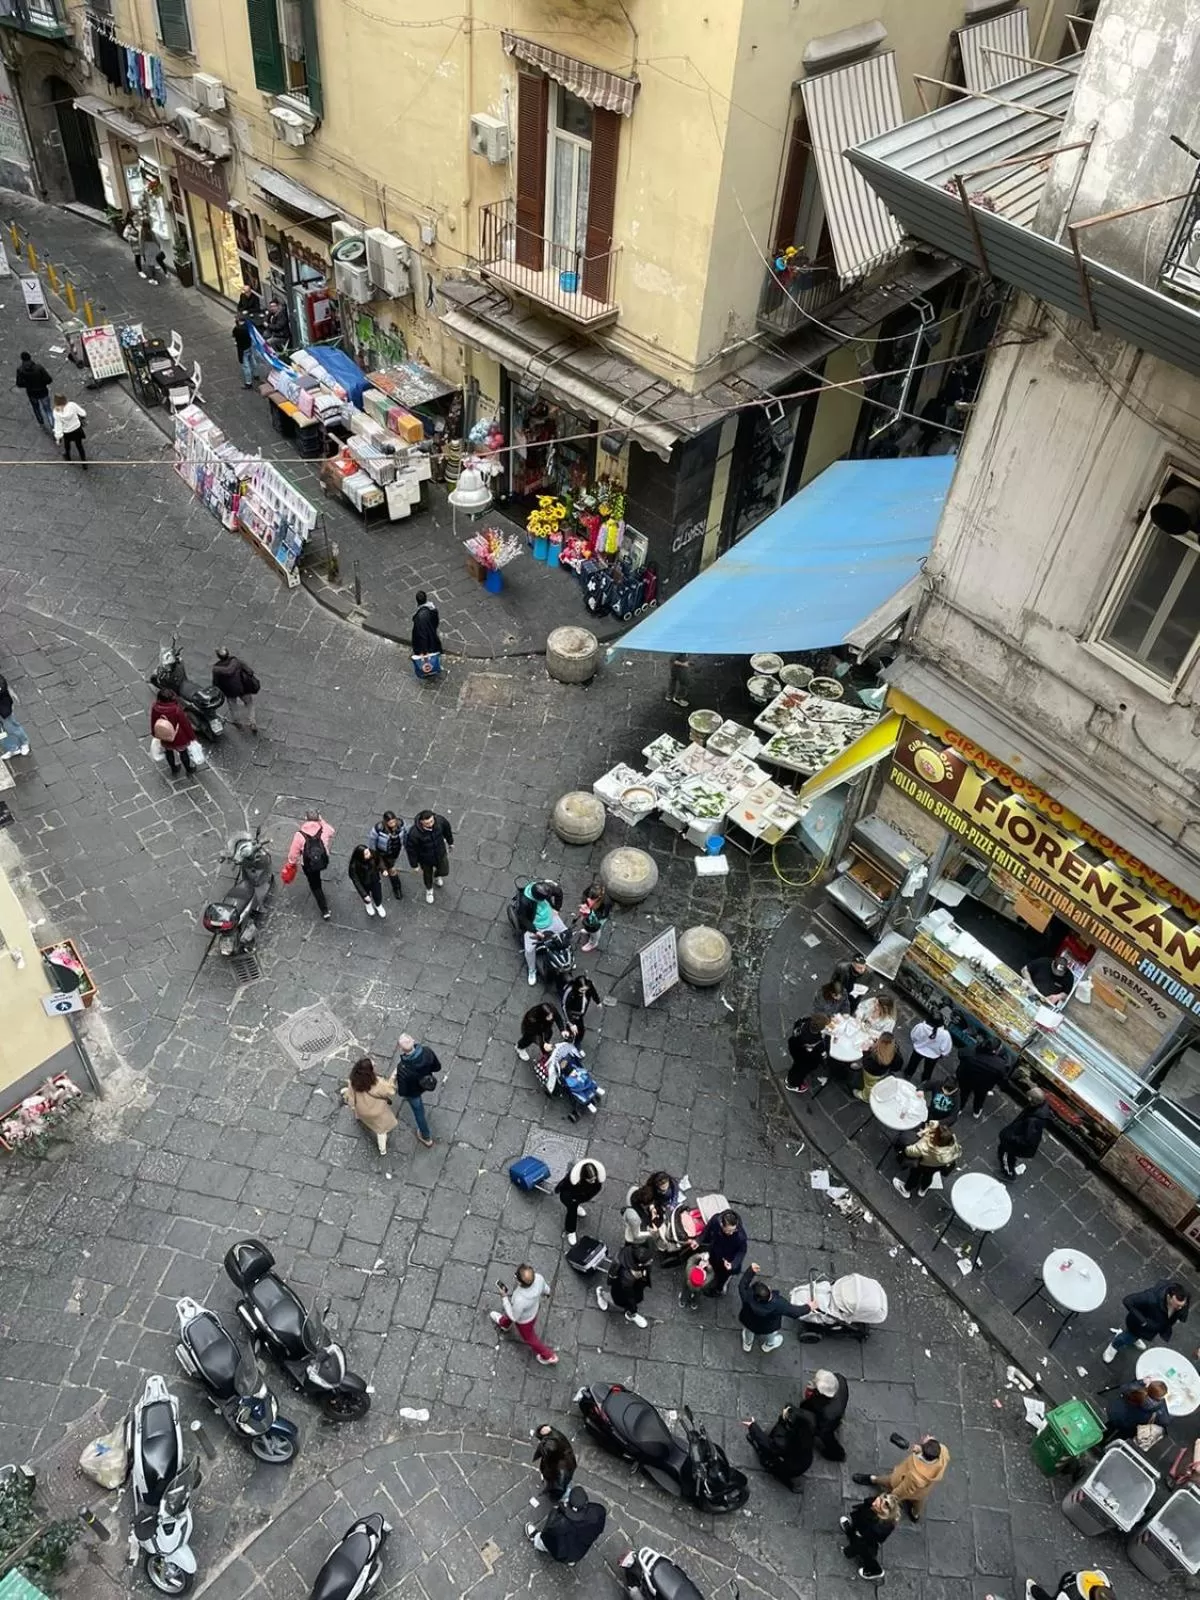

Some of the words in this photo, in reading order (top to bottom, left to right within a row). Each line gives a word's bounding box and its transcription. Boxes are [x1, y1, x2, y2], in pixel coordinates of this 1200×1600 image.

[890, 767, 917, 796] POLLO
[915, 789, 935, 810] allo
[945, 729, 1064, 815] GIRARROSTO
[1102, 966, 1167, 1020] FIORENZANO
